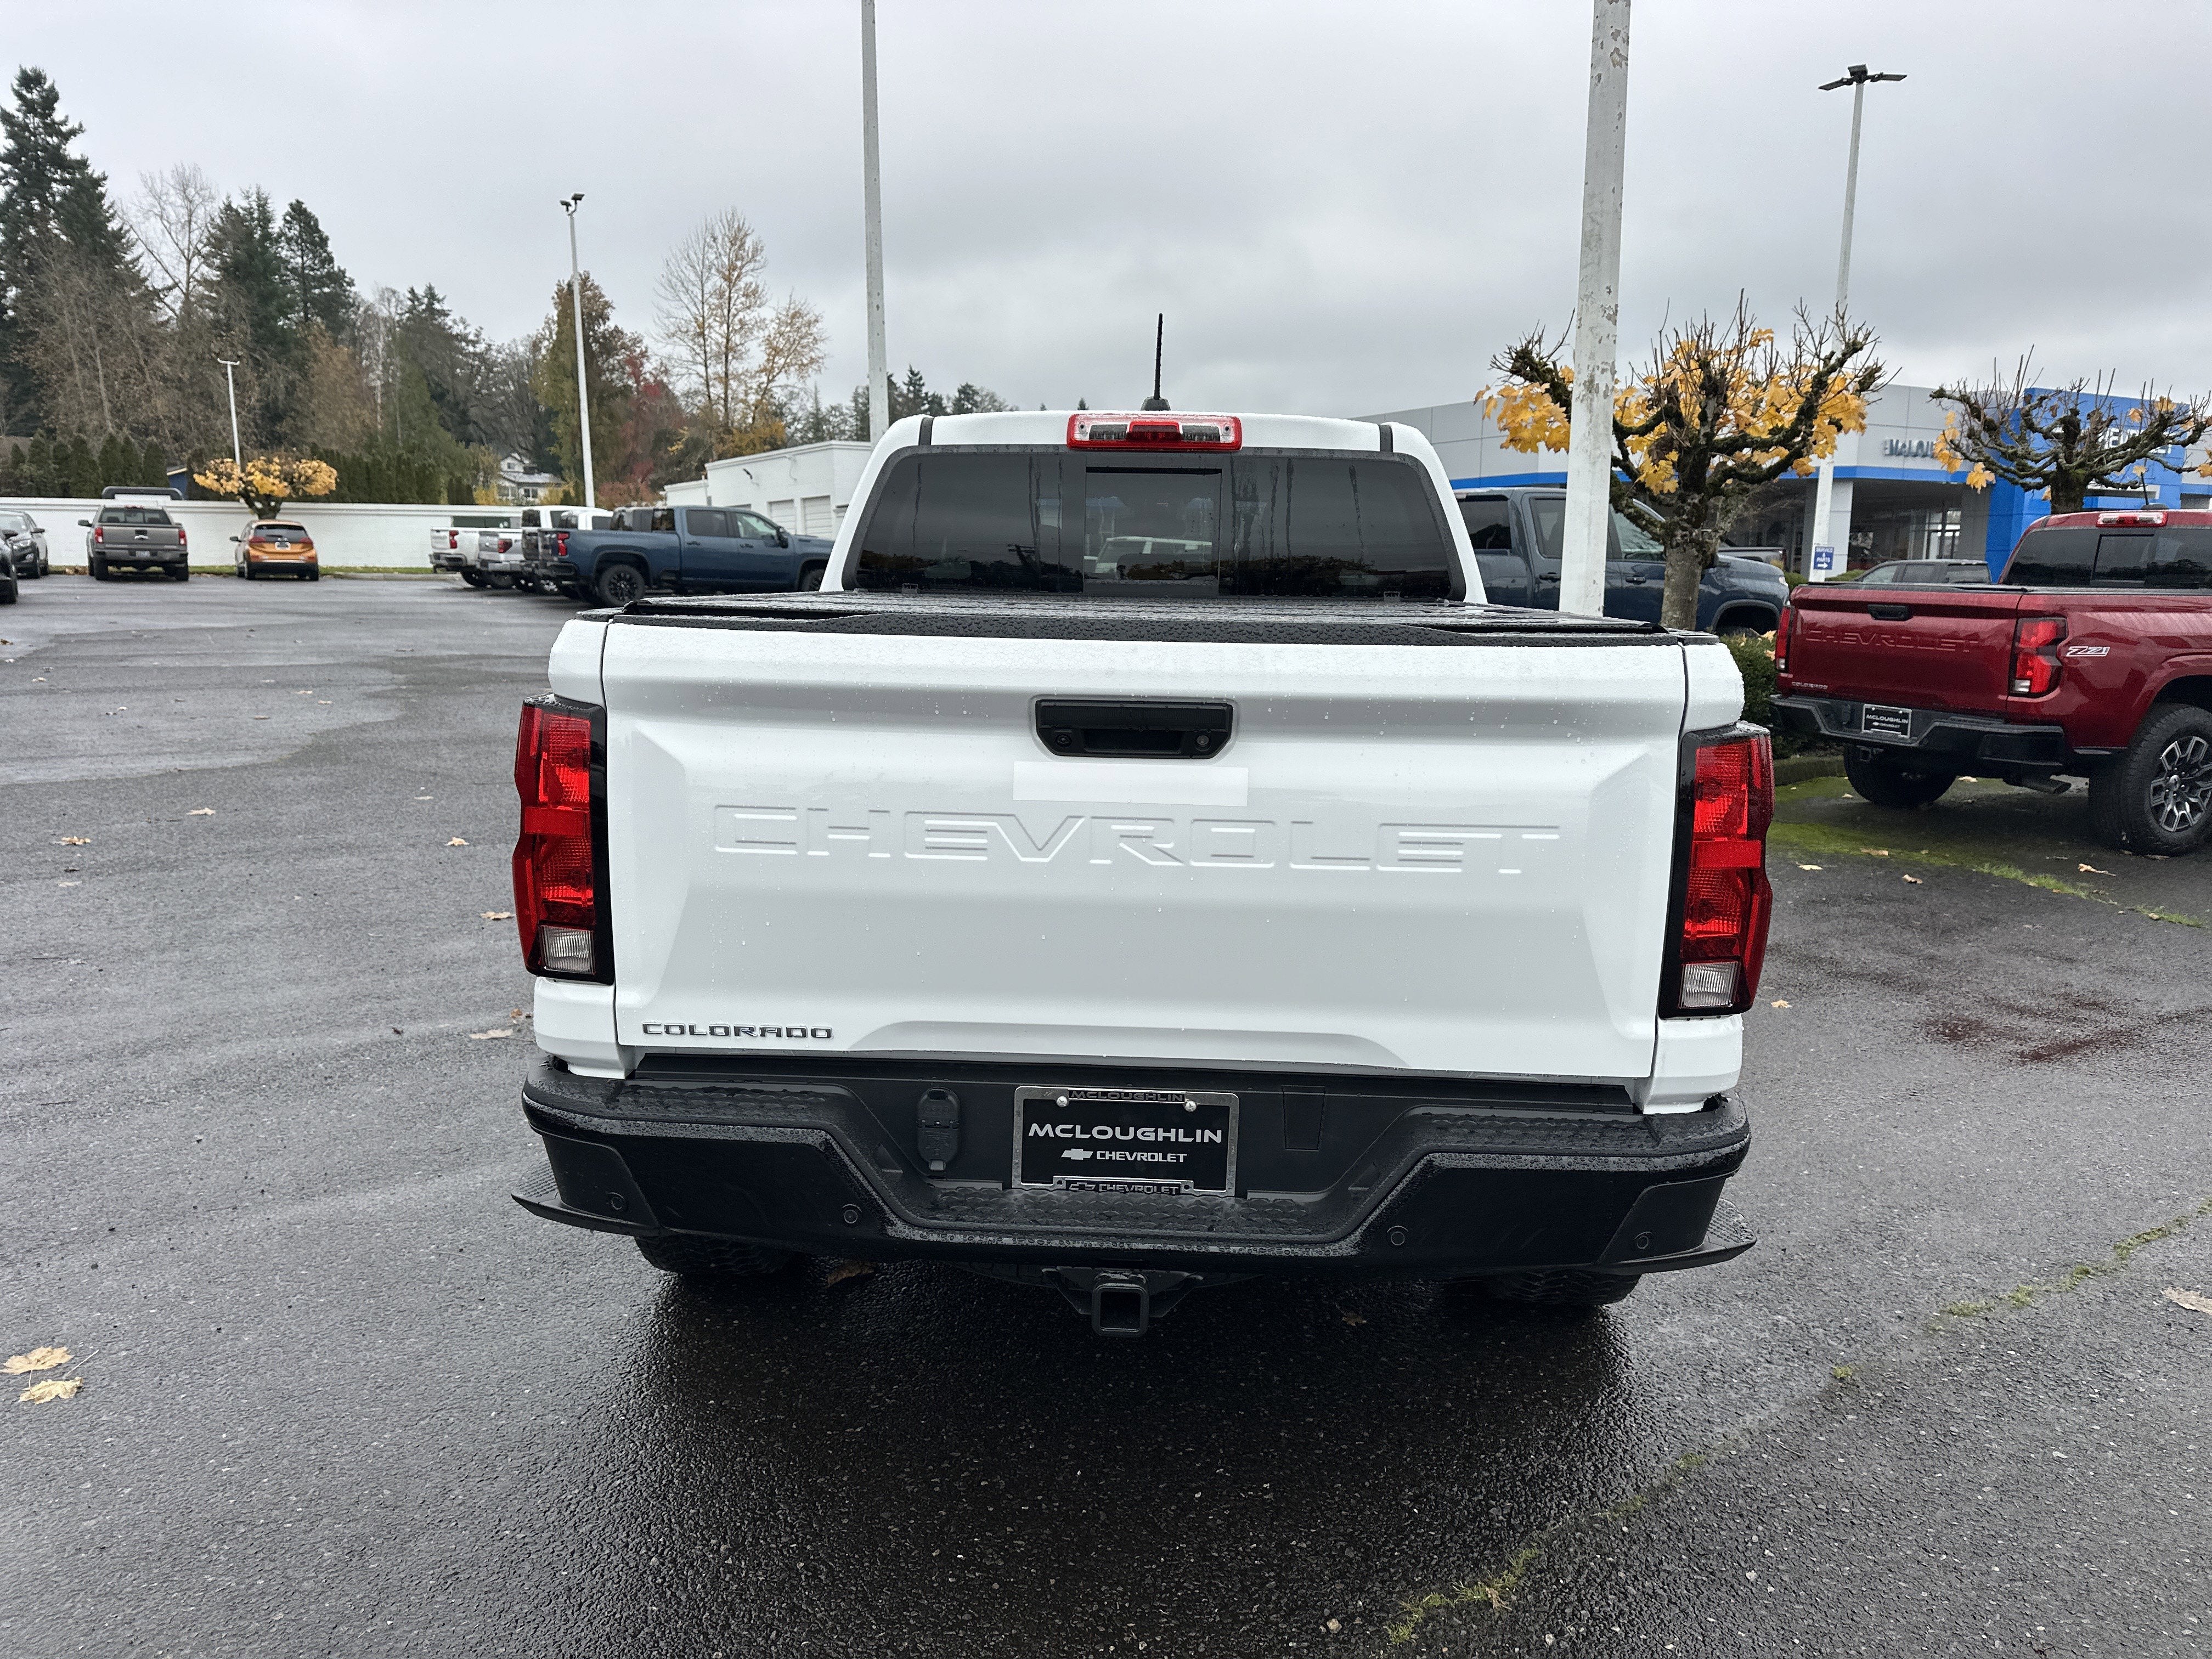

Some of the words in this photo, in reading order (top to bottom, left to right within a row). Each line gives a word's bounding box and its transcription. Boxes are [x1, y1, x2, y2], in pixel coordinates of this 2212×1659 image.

[1806, 630, 1979, 652] CHEVROLET
[2066, 646, 2111, 657] Z71
[1791, 681, 1828, 690] COLORADO
[714, 804, 1560, 874] CHEVROLET
[641, 1022, 833, 1039] COLORADO
[1071, 1090, 1183, 1102] MCLOUGHLIN
[1028, 1122, 1222, 1143] MCLOUGHLIN
[1096, 1150, 1187, 1163] CHEVROLET
[1098, 1183, 1179, 1195] CHEVROLET
